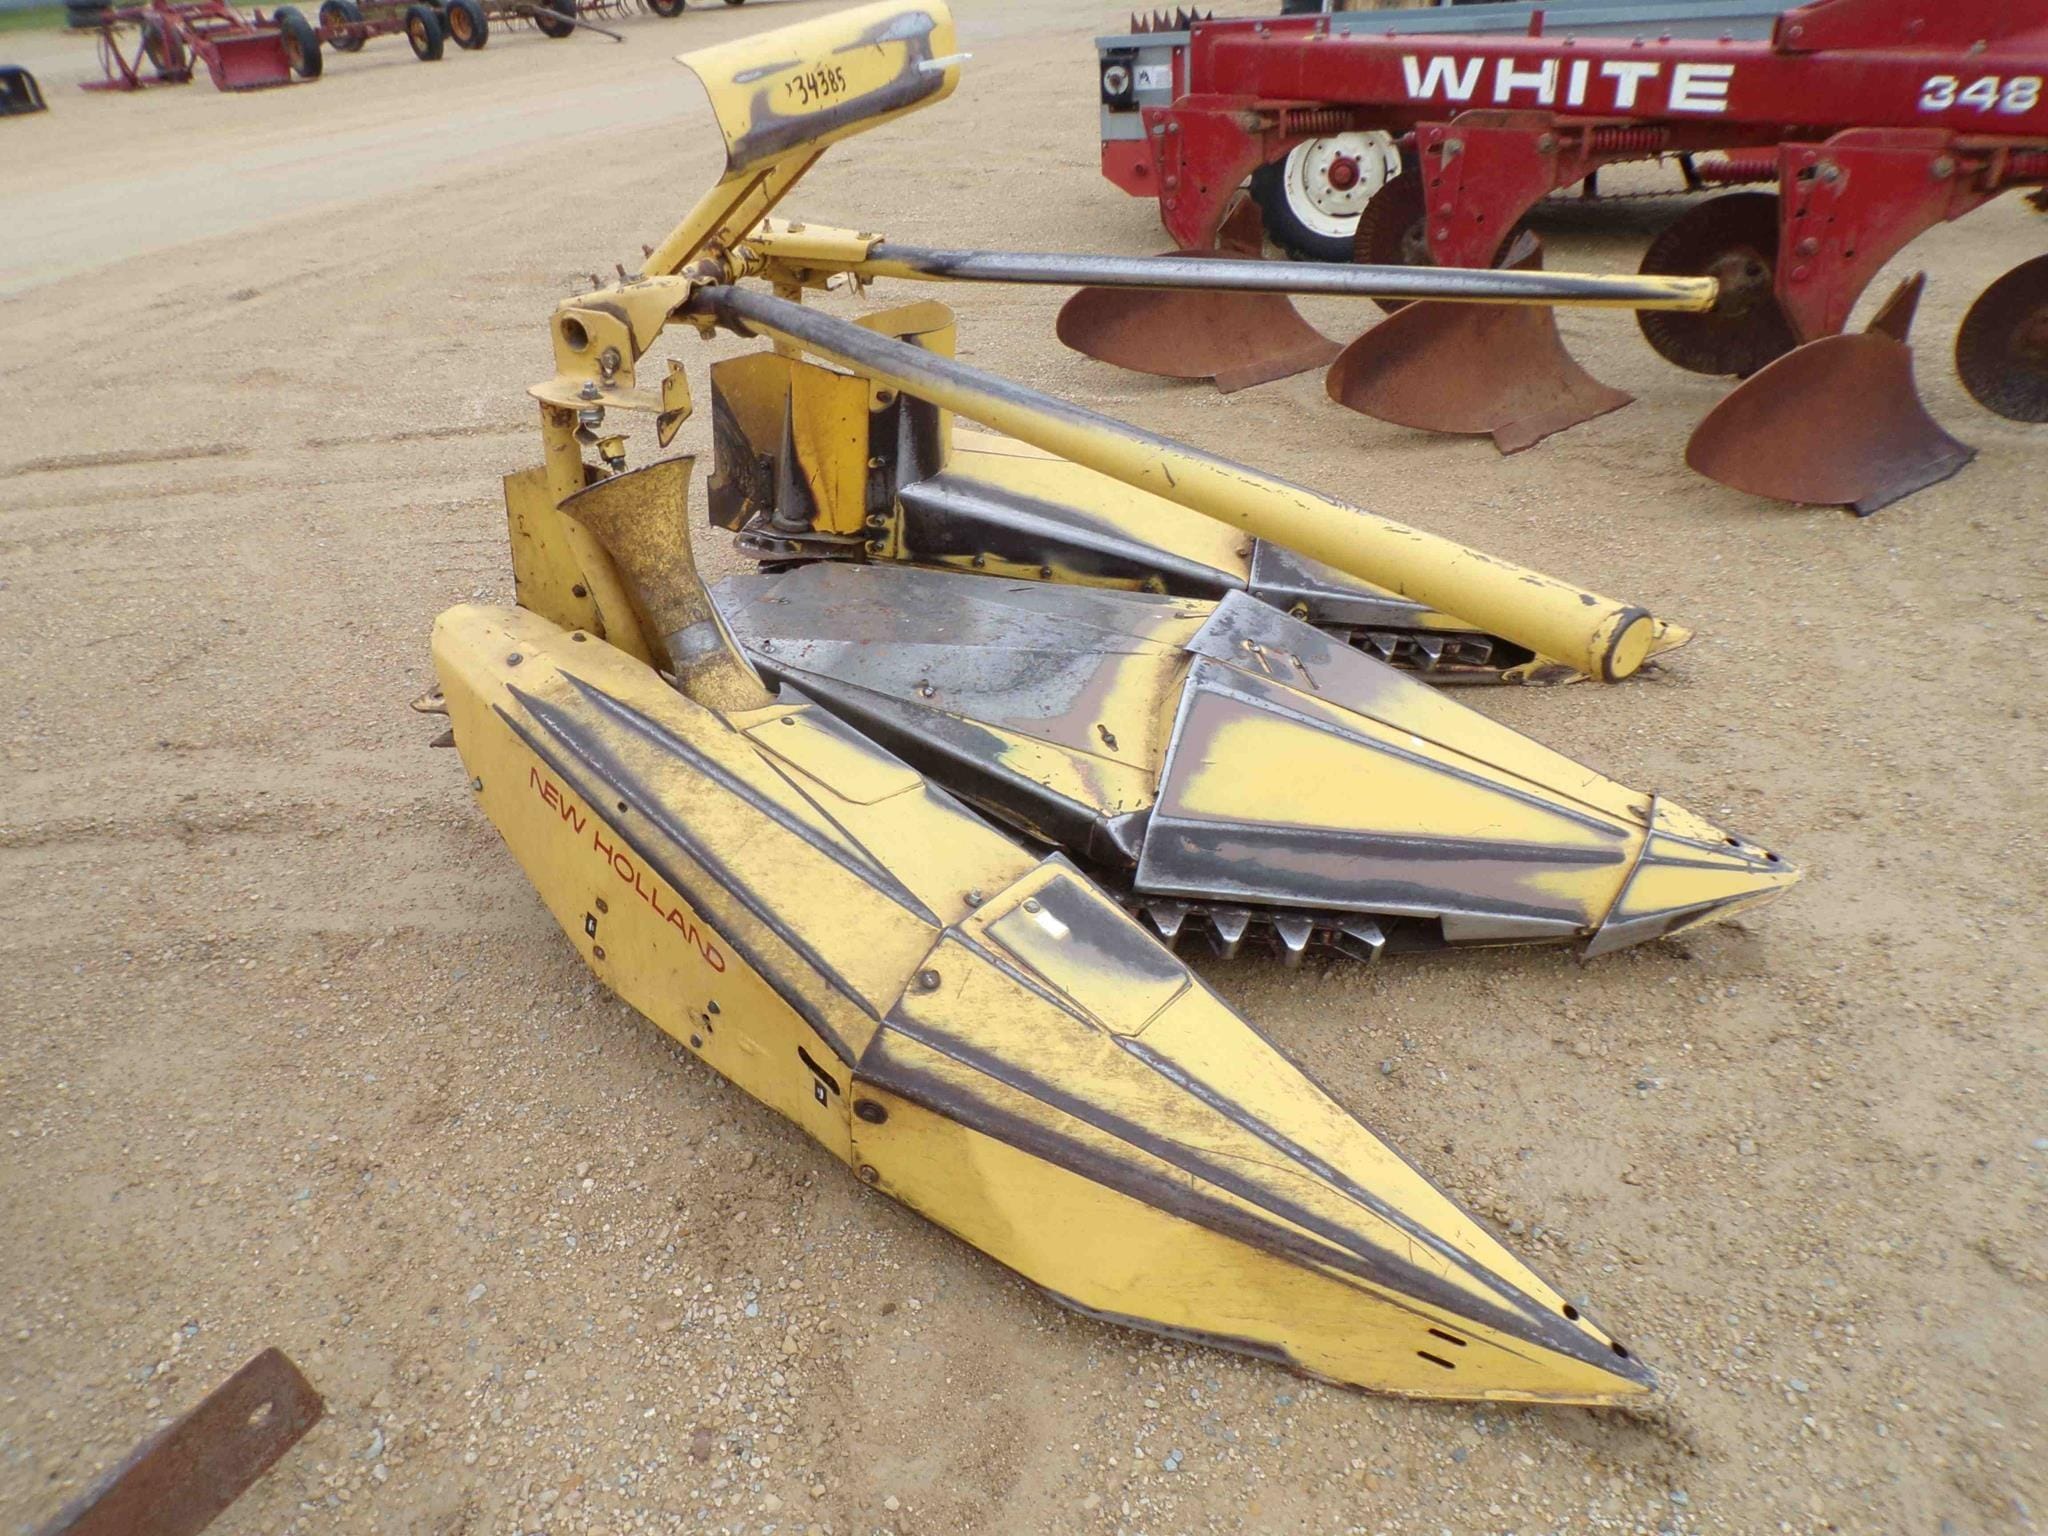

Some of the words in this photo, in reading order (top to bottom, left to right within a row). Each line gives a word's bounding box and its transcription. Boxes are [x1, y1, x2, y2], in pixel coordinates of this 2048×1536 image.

[1402, 55, 1736, 112] WHITE
[1918, 74, 2043, 113] 348
[529, 766, 587, 834] NEW
[593, 830, 727, 973] HOLLAND
